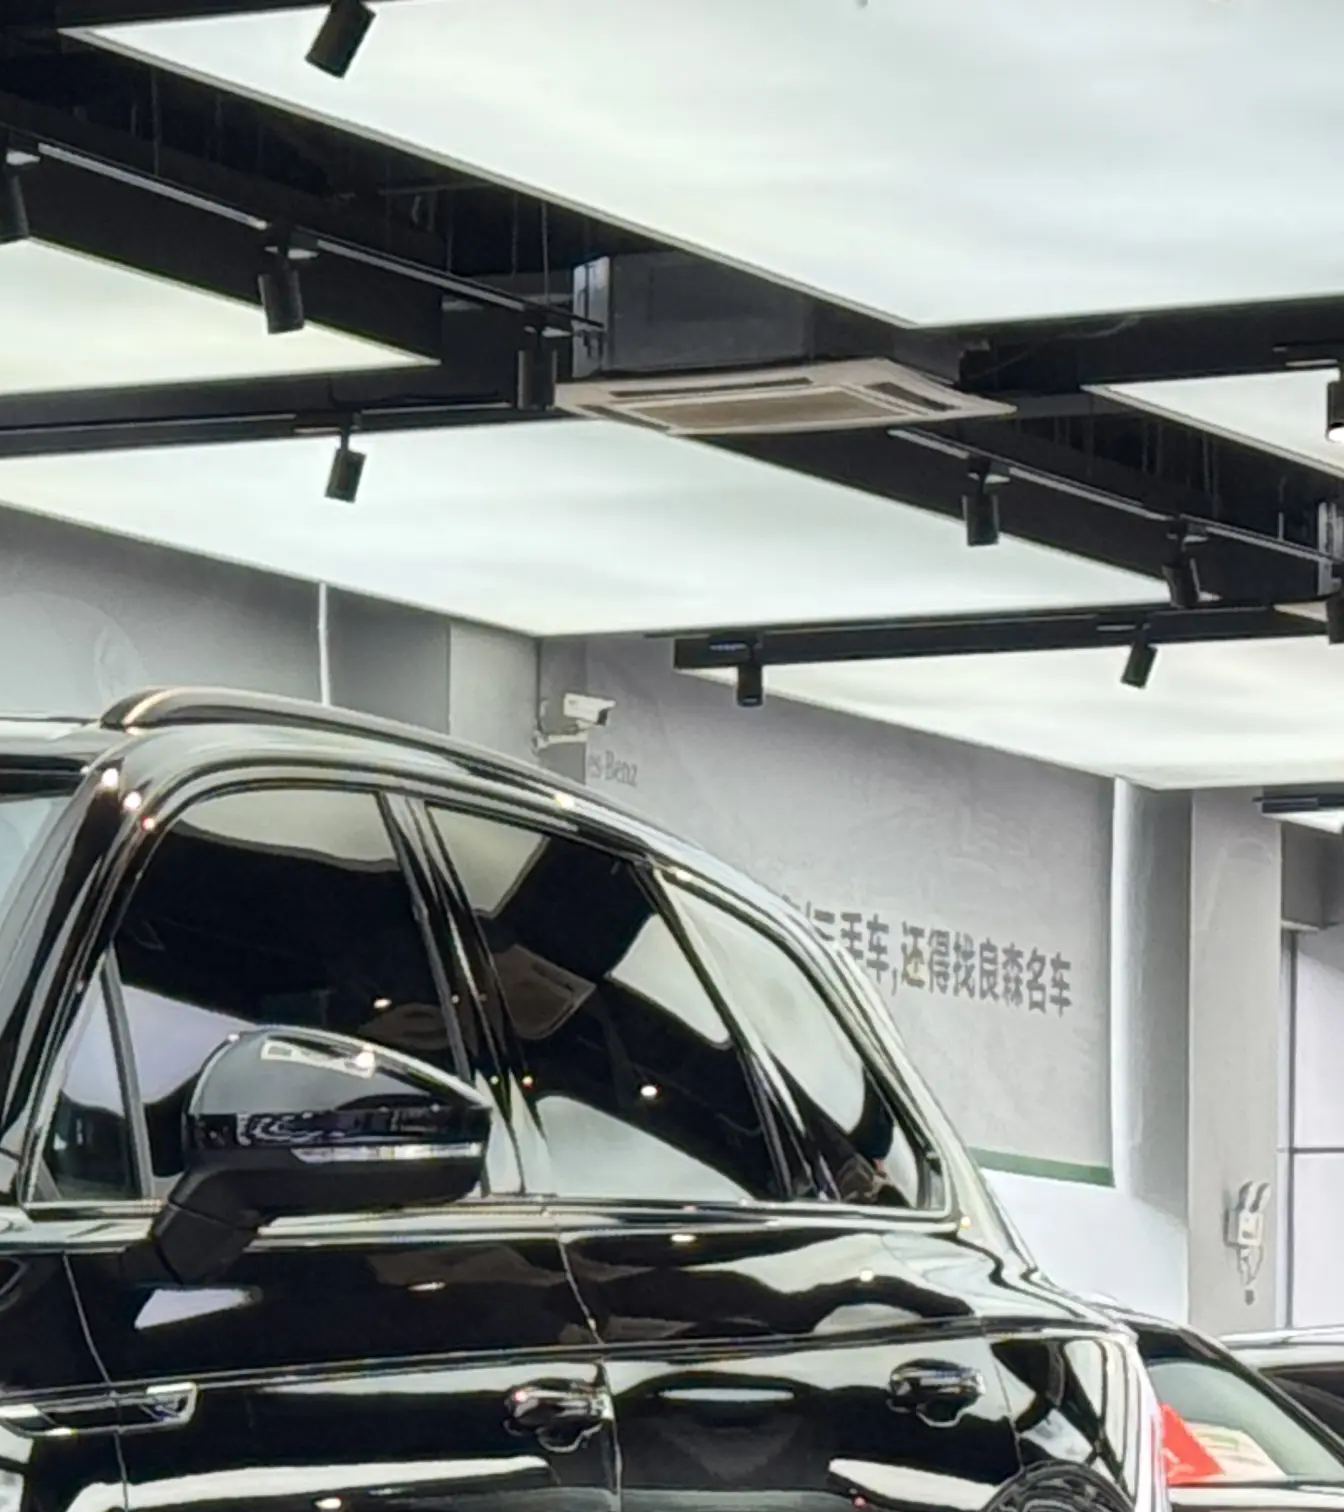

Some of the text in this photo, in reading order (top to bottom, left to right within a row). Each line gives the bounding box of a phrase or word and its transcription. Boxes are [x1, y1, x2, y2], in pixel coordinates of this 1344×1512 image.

[781, 894, 1072, 1018] 二手车,还得找良森名车
